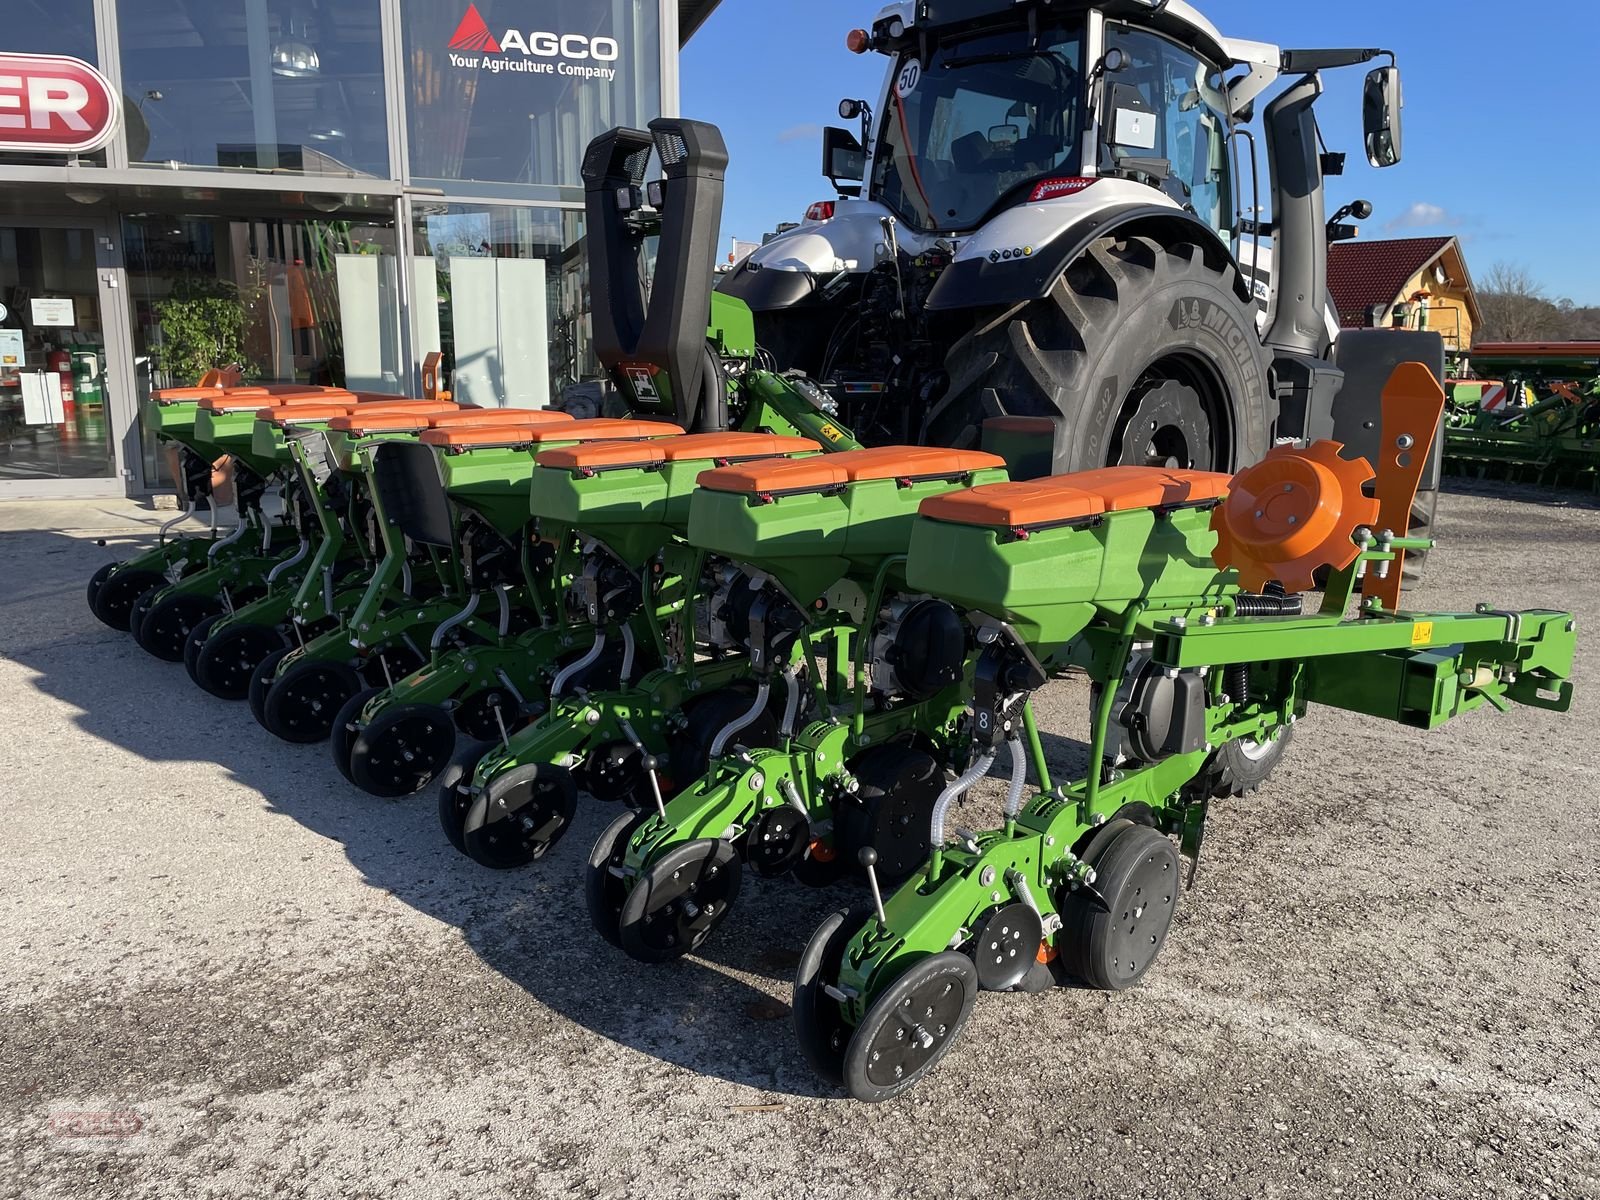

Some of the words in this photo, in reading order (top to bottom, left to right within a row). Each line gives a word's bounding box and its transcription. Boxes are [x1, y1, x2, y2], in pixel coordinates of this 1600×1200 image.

[500, 29, 618, 61] AGCO
[449, 53, 479, 67] Your
[482, 56, 554, 74] Agriculture
[557, 62, 616, 81] Company
[899, 65, 918, 90] 50
[1204, 303, 1264, 432] MICHELIN
[590, 603, 596, 616] 6
[754, 648, 761, 663] 7
[979, 711, 988, 729] 8
